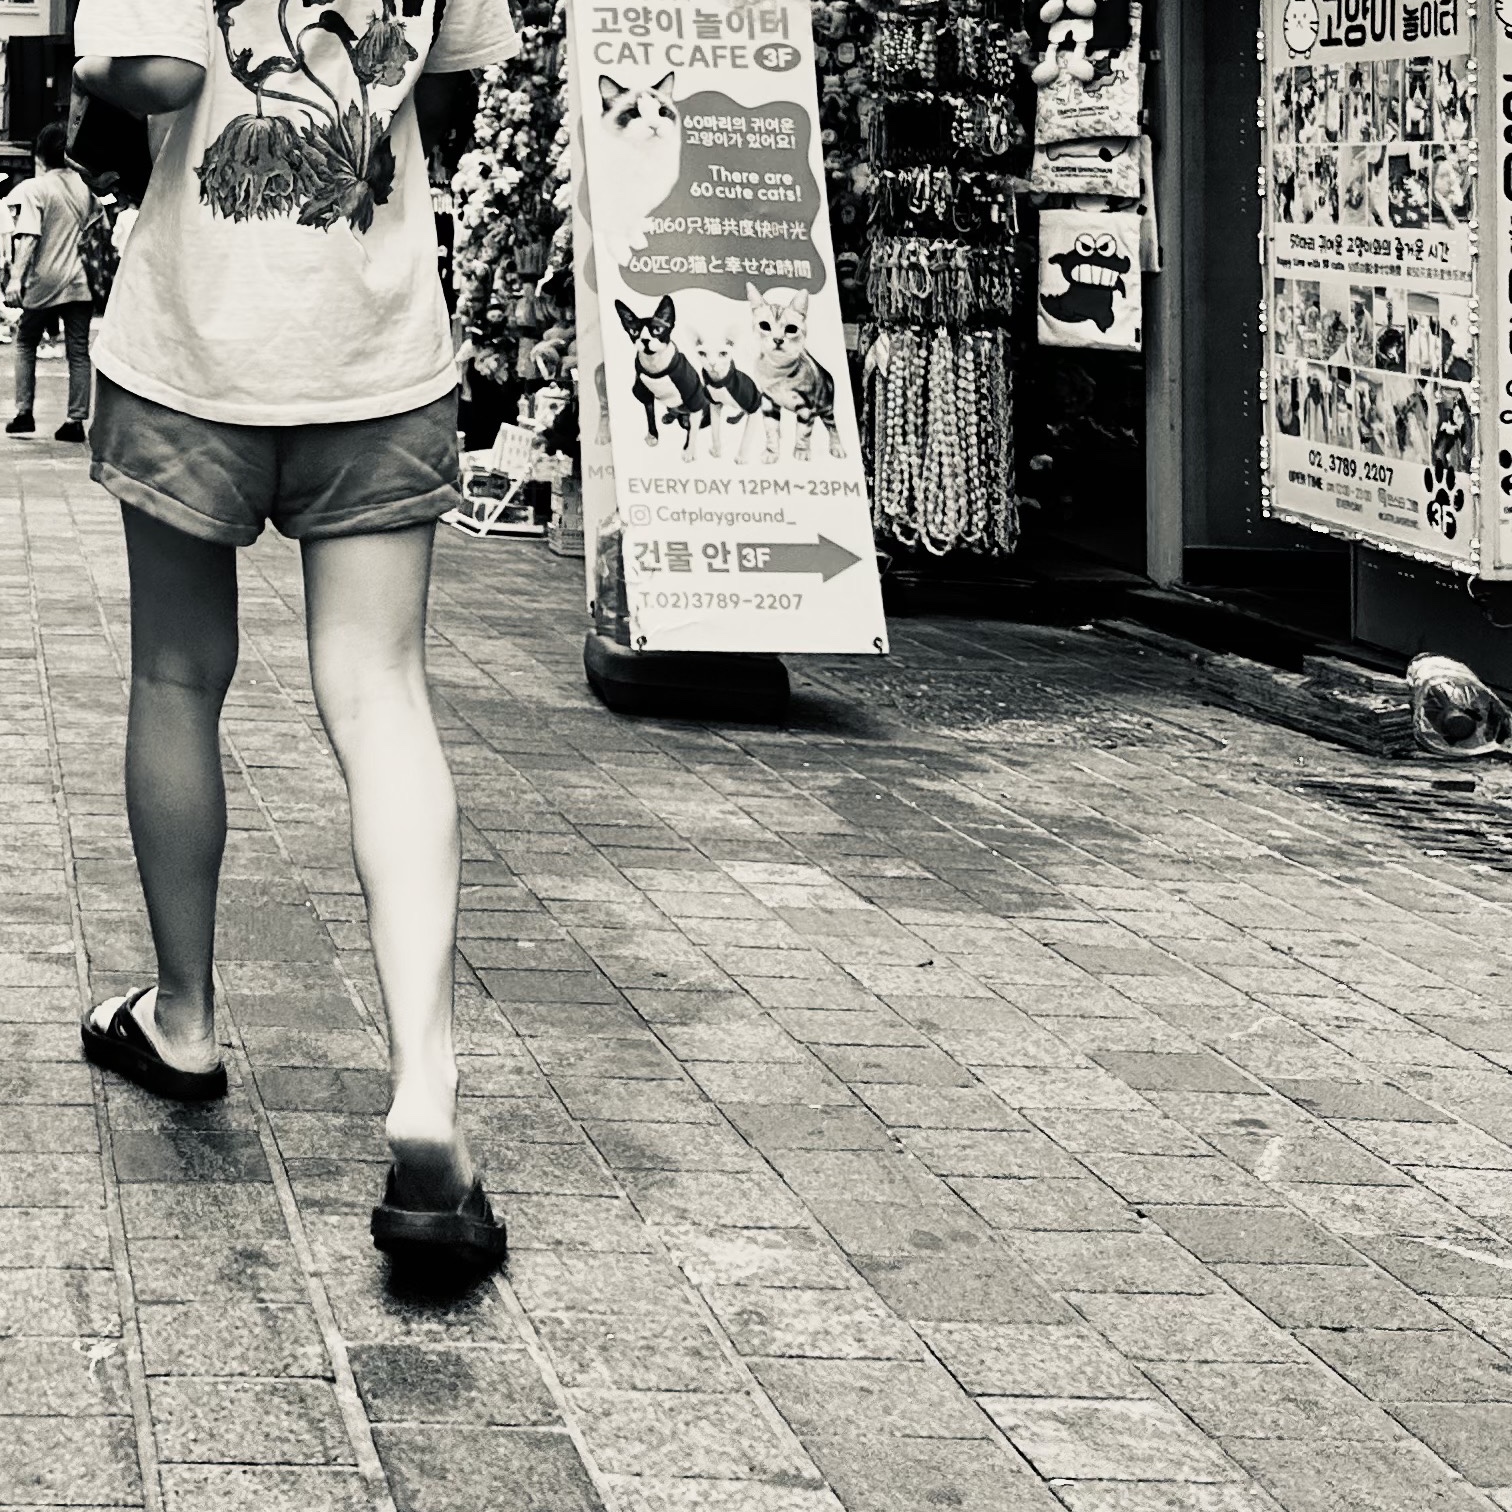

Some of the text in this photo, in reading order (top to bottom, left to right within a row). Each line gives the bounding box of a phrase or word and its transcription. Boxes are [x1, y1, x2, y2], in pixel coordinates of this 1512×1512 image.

[591, 6, 789, 40] 고양이 놀이터
[593, 42, 794, 70] CAT CAFE 3F
[683, 115, 795, 134] 60마리의 귀여운
[686, 130, 796, 150] 고양이가 있어요!
[708, 164, 794, 186] There are
[689, 181, 802, 203] 60 cute cats!
[1395, 237, 1424, 261] 즐거운
[1428, 241, 1450, 263] 시간
[628, 254, 813, 280] 60匹の猫と幸せな時間
[1308, 449, 1394, 487] 02.3789.2207
[628, 477, 861, 498] EVERY DAY 12PM~23PM
[656, 505, 797, 527] Catplayground_
[634, 540, 772, 574] 건물 안 3F
[638, 591, 804, 611] T.02)3789-2207
